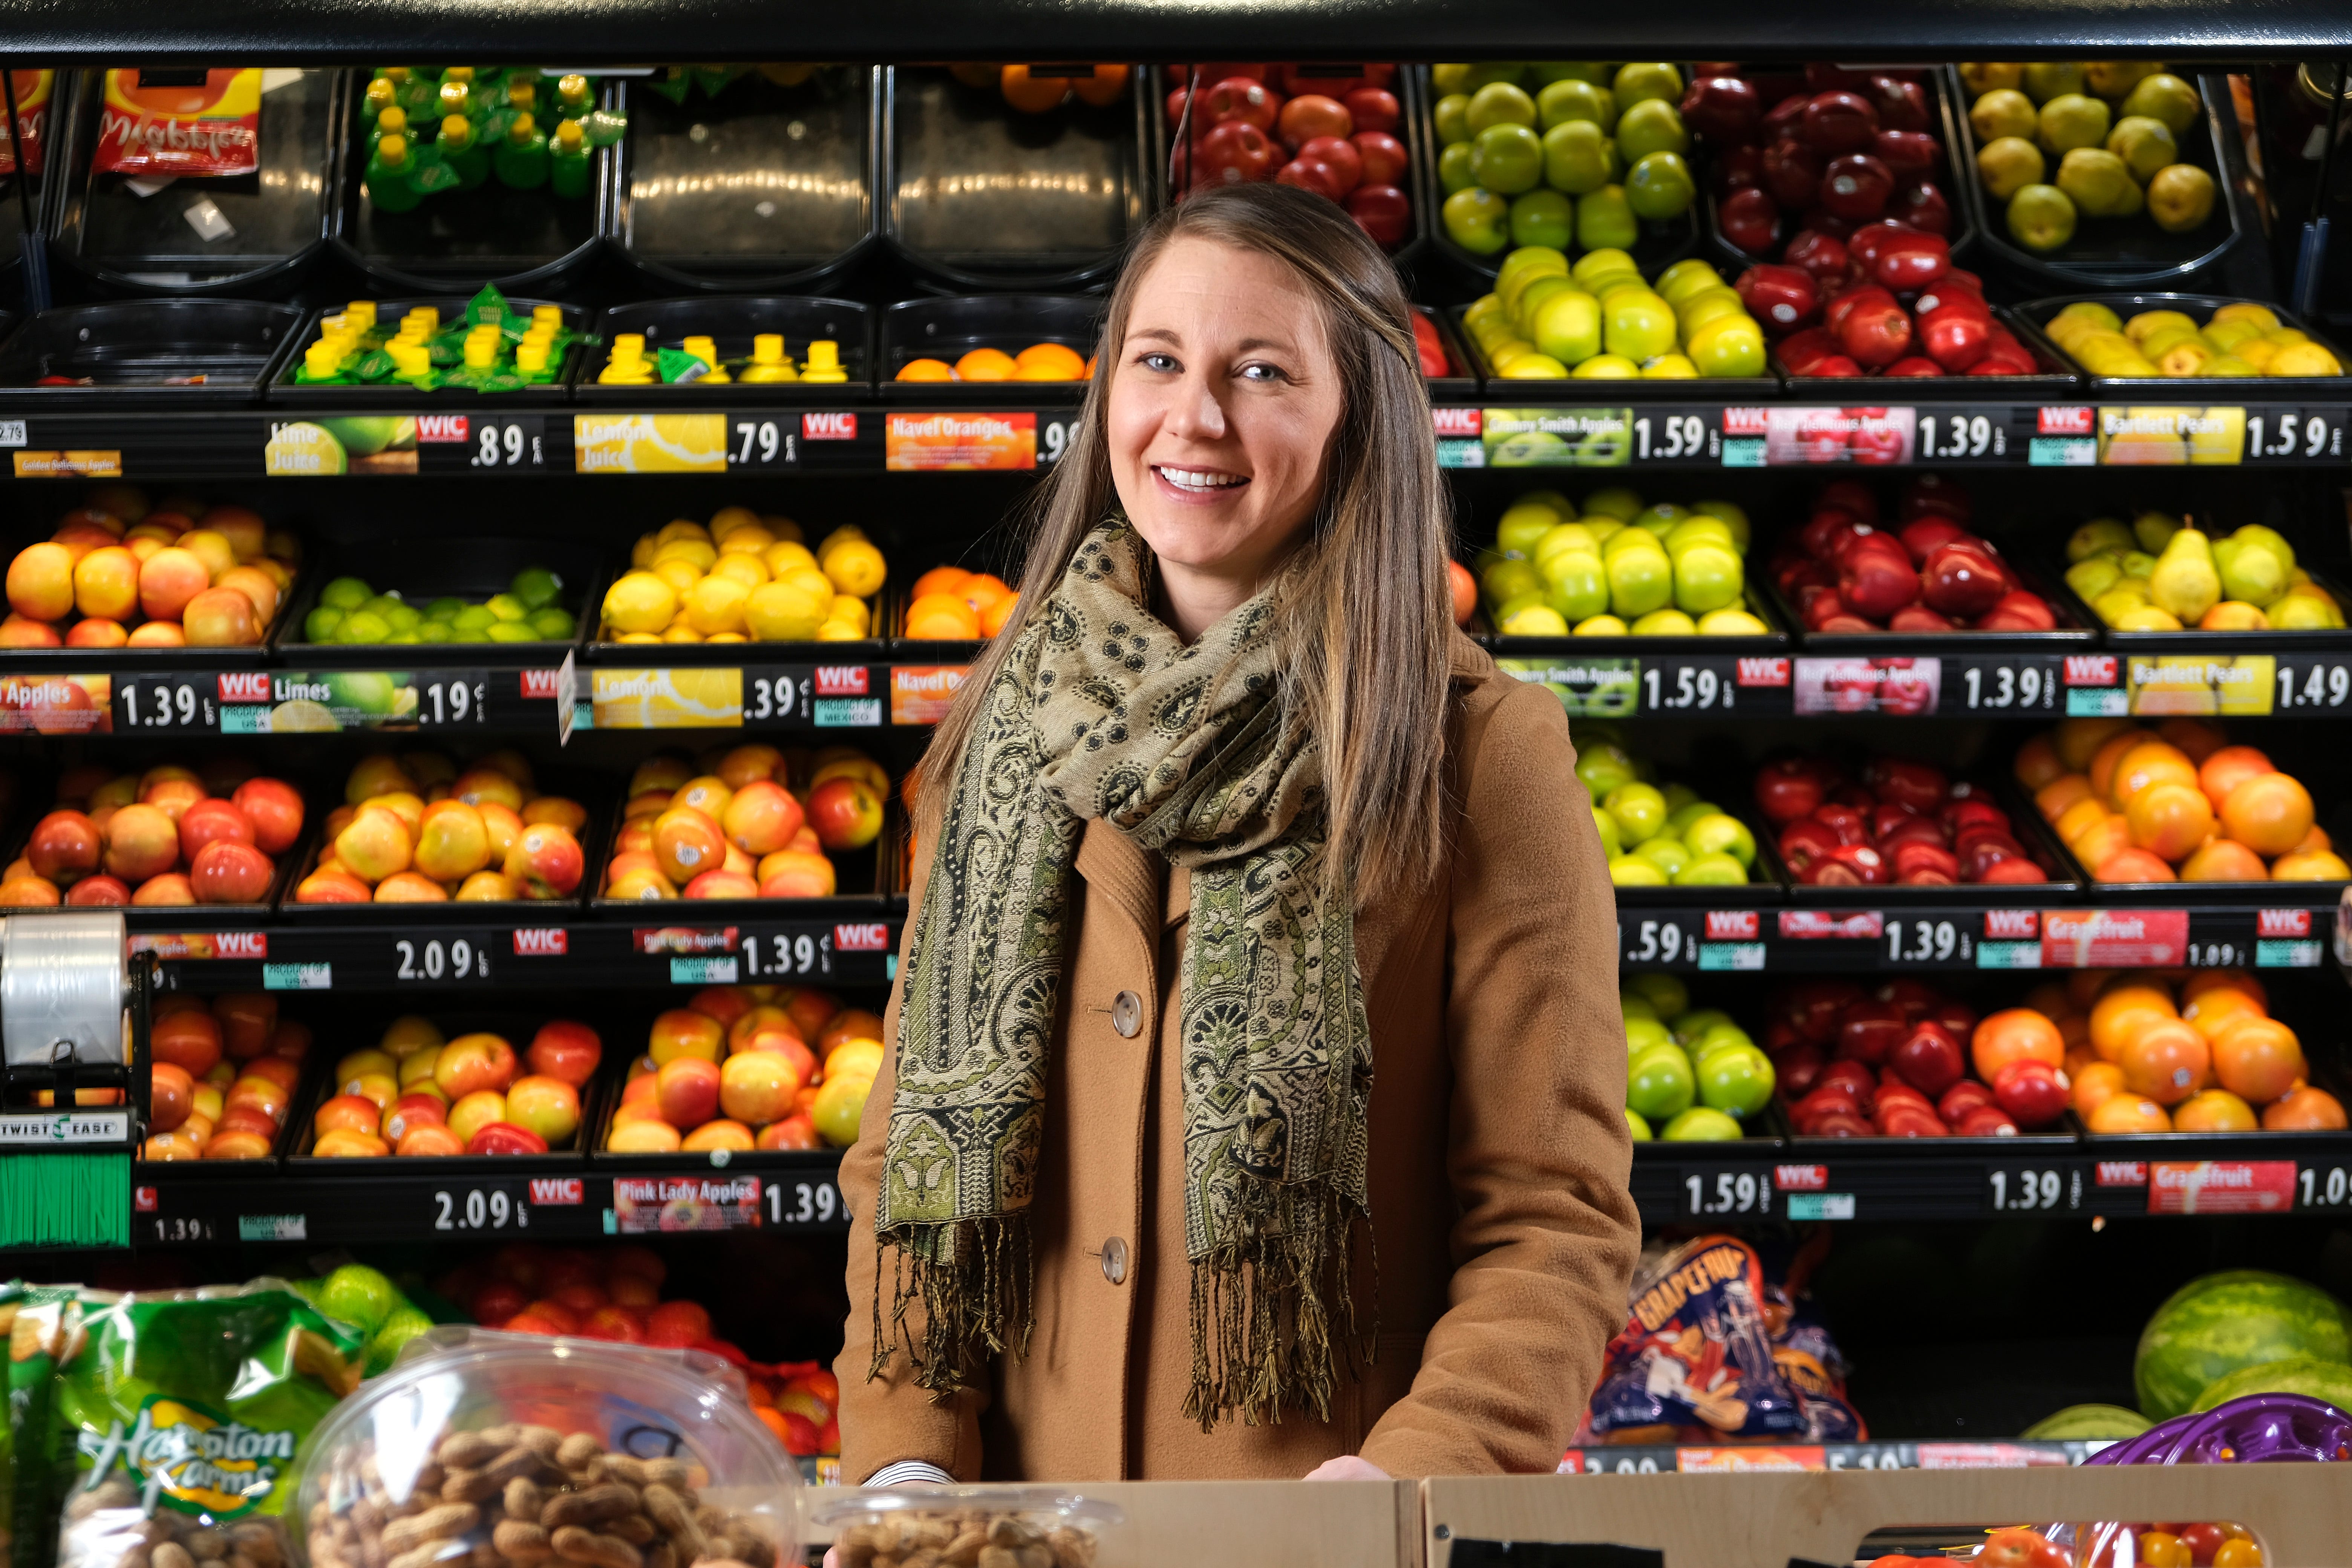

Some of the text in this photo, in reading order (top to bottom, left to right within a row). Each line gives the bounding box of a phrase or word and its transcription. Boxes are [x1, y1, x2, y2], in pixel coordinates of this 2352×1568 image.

[418, 416, 466, 435] WIC
[805, 413, 853, 433] WIC
[1435, 409, 1478, 429] WIC
[1489, 416, 1623, 435] Granny Smith Apples
[1724, 407, 1767, 426] WIC
[1860, 415, 1905, 436] Apples
[2041, 407, 2090, 427] WIC
[2104, 413, 2225, 435] Bartlett Pears
[271, 422, 318, 444] Lime
[582, 421, 645, 441] Lemon
[893, 418, 1011, 439] Navel Oranges
[1634, 416, 1704, 458] 1.59
[1919, 416, 1991, 458] 1.39
[2247, 415, 2328, 457] 1.59
[471, 424, 525, 466] .89
[727, 421, 779, 464] .79
[23, 459, 115, 472] Golden Delicious Apples
[273, 452, 320, 470] Juice
[582, 447, 630, 467] Juice
[818, 666, 864, 686] WIC
[1547, 668, 1588, 684] Smith
[1589, 668, 1633, 687] Apples
[1739, 658, 1788, 678] WIC
[2067, 656, 2115, 678] WIC
[2133, 663, 2254, 684] Bartlett Pears
[220, 674, 268, 692] WIC
[274, 679, 332, 701] Limes
[524, 670, 557, 690] WI
[599, 677, 671, 696] Lemons
[897, 672, 944, 691] Navel
[1644, 667, 1719, 710] 1.59
[1964, 667, 2041, 709] 1.39
[2277, 664, 2350, 708] 1.49
[6, 681, 71, 709] Apples
[120, 684, 196, 726] 1.39
[418, 680, 471, 724] .19
[743, 676, 795, 720] .39
[1707, 912, 1756, 932] WIC
[1987, 911, 2034, 931] WIC
[2047, 916, 2145, 939] Grapefruit
[2262, 910, 2306, 930] WIC
[216, 933, 262, 951] WIC
[516, 928, 562, 948] WIC
[643, 934, 729, 949] Pink Lady Apples
[837, 925, 883, 945] WIC
[1619, 920, 1681, 963] .59
[1885, 920, 1956, 961] 1.39
[396, 939, 472, 979] 2.09
[742, 934, 815, 975] 1.39
[2188, 943, 2234, 966] 1.09
[1, 1122, 113, 1136] TWIST EASE
[1778, 1165, 1823, 1184] WIC
[2101, 1162, 2146, 1182] WIC
[2156, 1165, 2254, 1188] Grapefruit
[531, 1178, 579, 1199] WIC
[619, 1180, 755, 1204] Pink Lady Apples
[1685, 1172, 1756, 1214] 1.59
[1989, 1169, 2061, 1210] 1.39
[2300, 1167, 2352, 1207] 1.0
[435, 1188, 510, 1230] 2.09
[765, 1182, 836, 1223] 1.39
[155, 1218, 201, 1241] 1.39
[78, 1409, 295, 1491] Hampton
[137, 1453, 277, 1519] Farms
